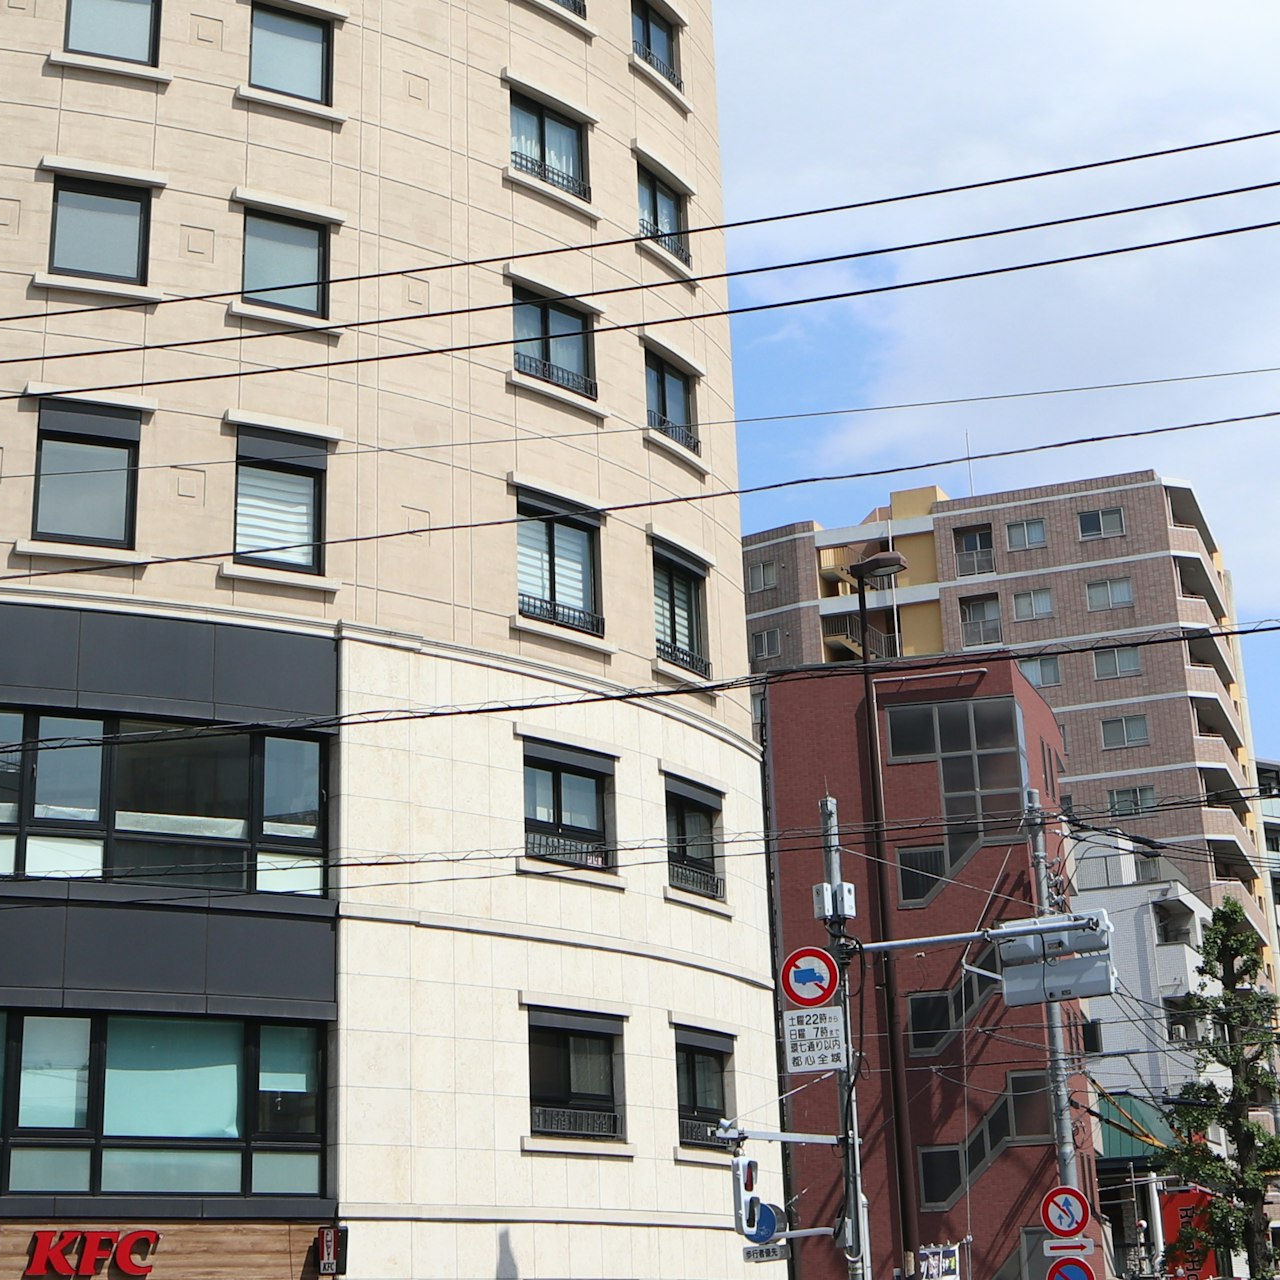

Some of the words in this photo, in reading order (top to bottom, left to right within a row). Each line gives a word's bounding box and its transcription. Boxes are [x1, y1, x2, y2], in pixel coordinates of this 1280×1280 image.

[789, 1013, 838, 1026] 土曜22時から
[791, 1039, 840, 1053] 環七通り以内
[792, 1053, 841, 1067] 都心全域
[25, 1230, 157, 1276] KFC
[322, 1262, 335, 1271] KFC
